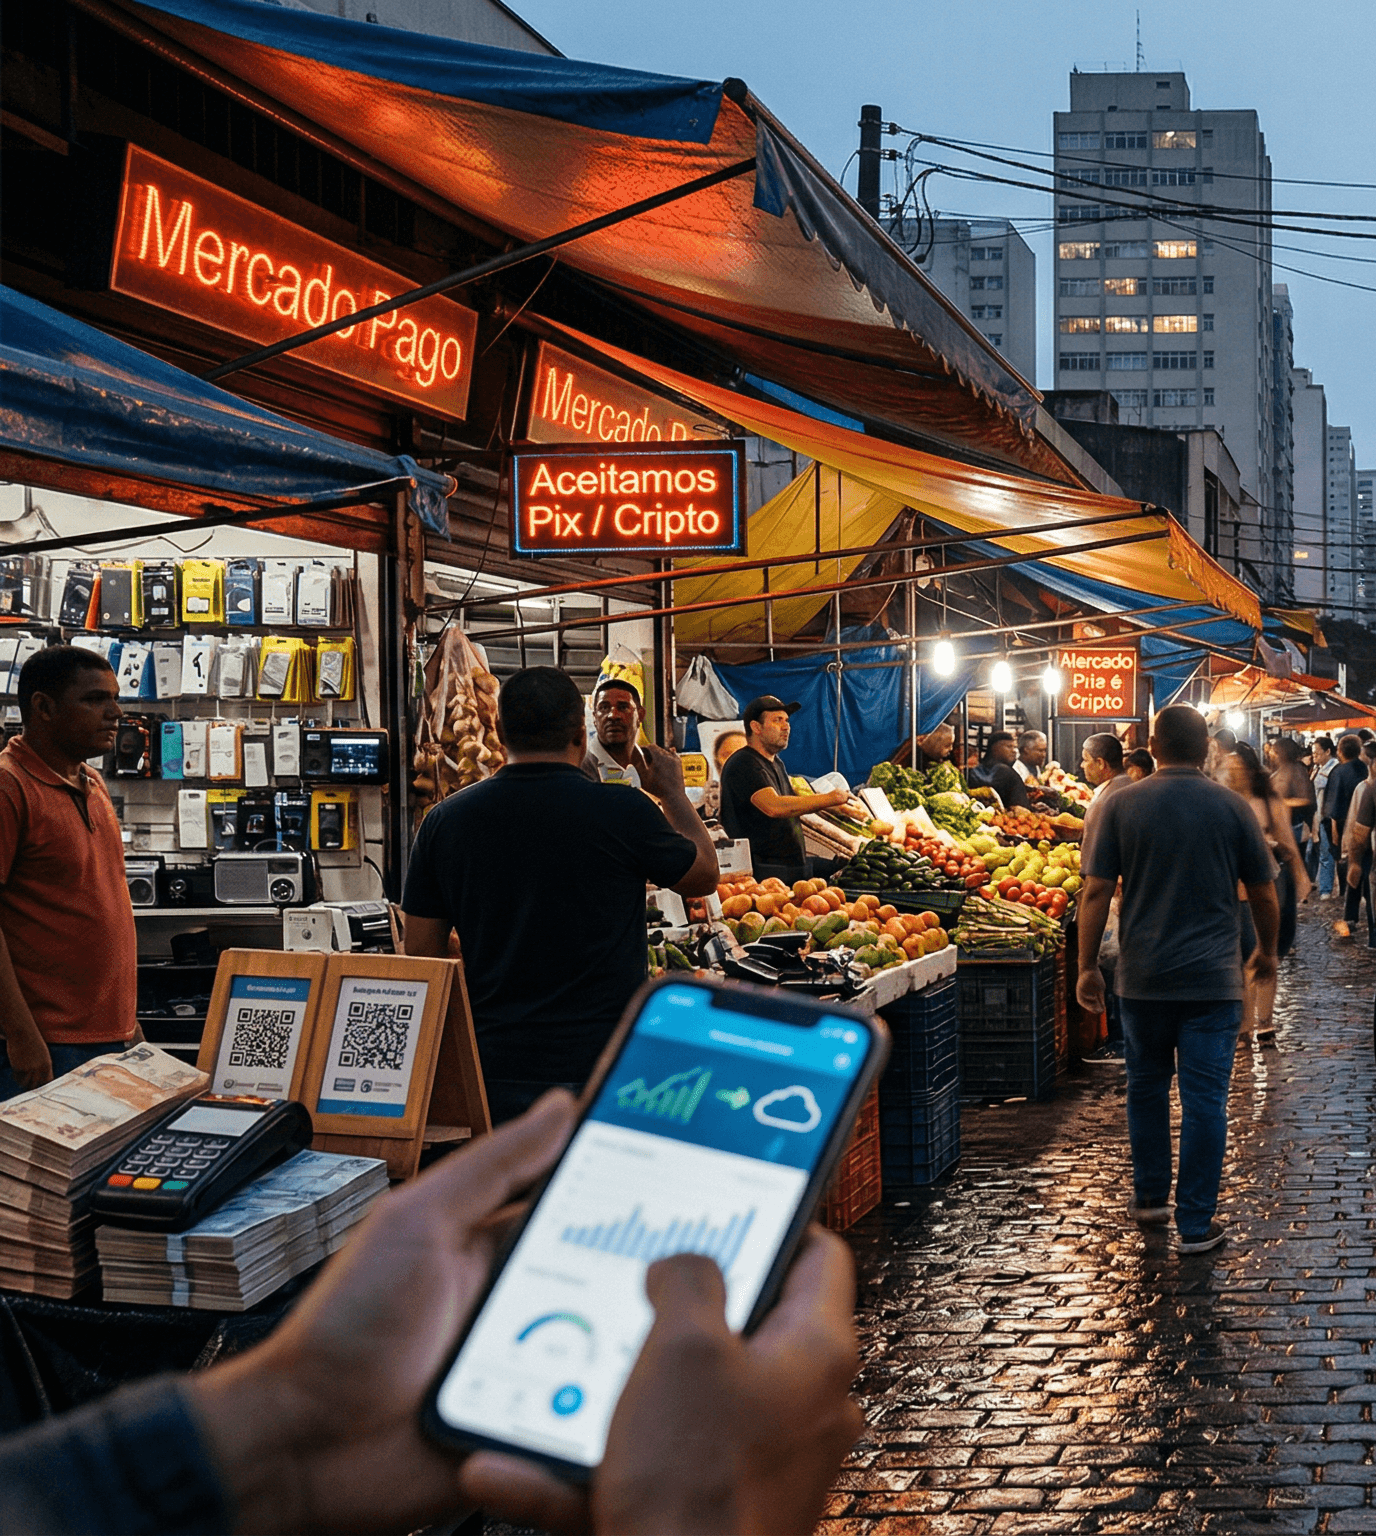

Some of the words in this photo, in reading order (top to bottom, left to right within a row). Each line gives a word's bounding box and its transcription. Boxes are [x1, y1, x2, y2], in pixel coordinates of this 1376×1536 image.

[138, 184, 357, 338] Mercado
[369, 290, 462, 387] Pago
[529, 462, 717, 496] Aceitamos
[528, 504, 584, 538] Pix
[591, 504, 604, 537] /
[614, 503, 720, 543] Cripto
[1067, 692, 1124, 714] Cripto
